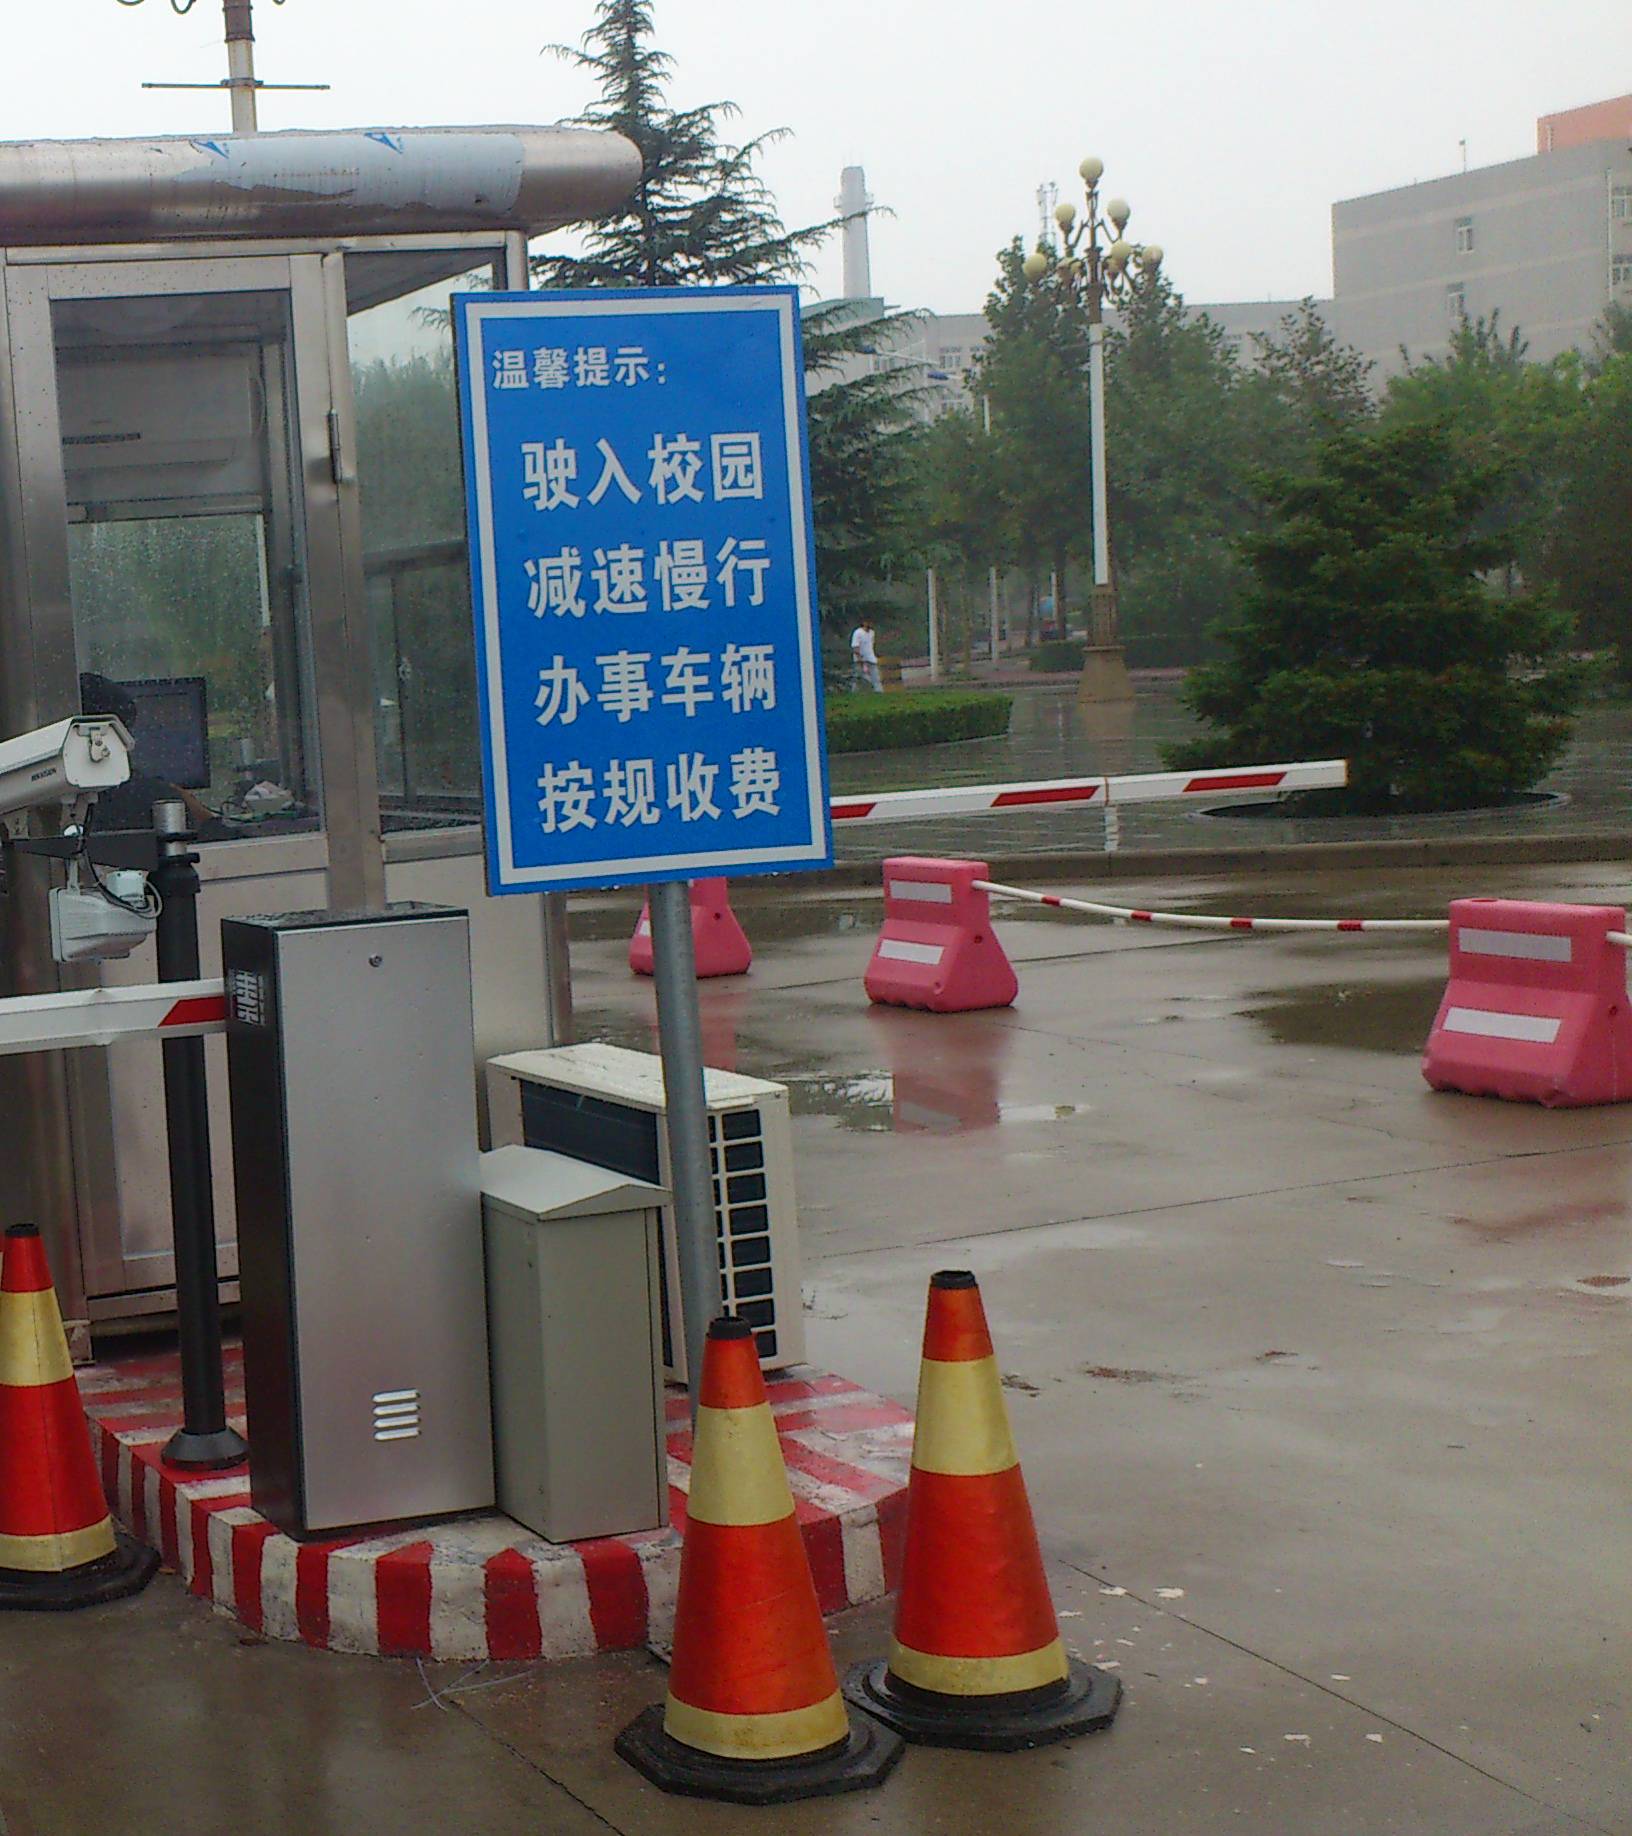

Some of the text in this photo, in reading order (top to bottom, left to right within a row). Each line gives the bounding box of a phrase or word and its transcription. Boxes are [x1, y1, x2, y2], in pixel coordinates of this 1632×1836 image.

[519, 430, 765, 513] 驶入校园
[523, 535, 772, 619] 减速慢行
[532, 642, 777, 727] 办事车辆
[536, 746, 782, 834] 按规收费
